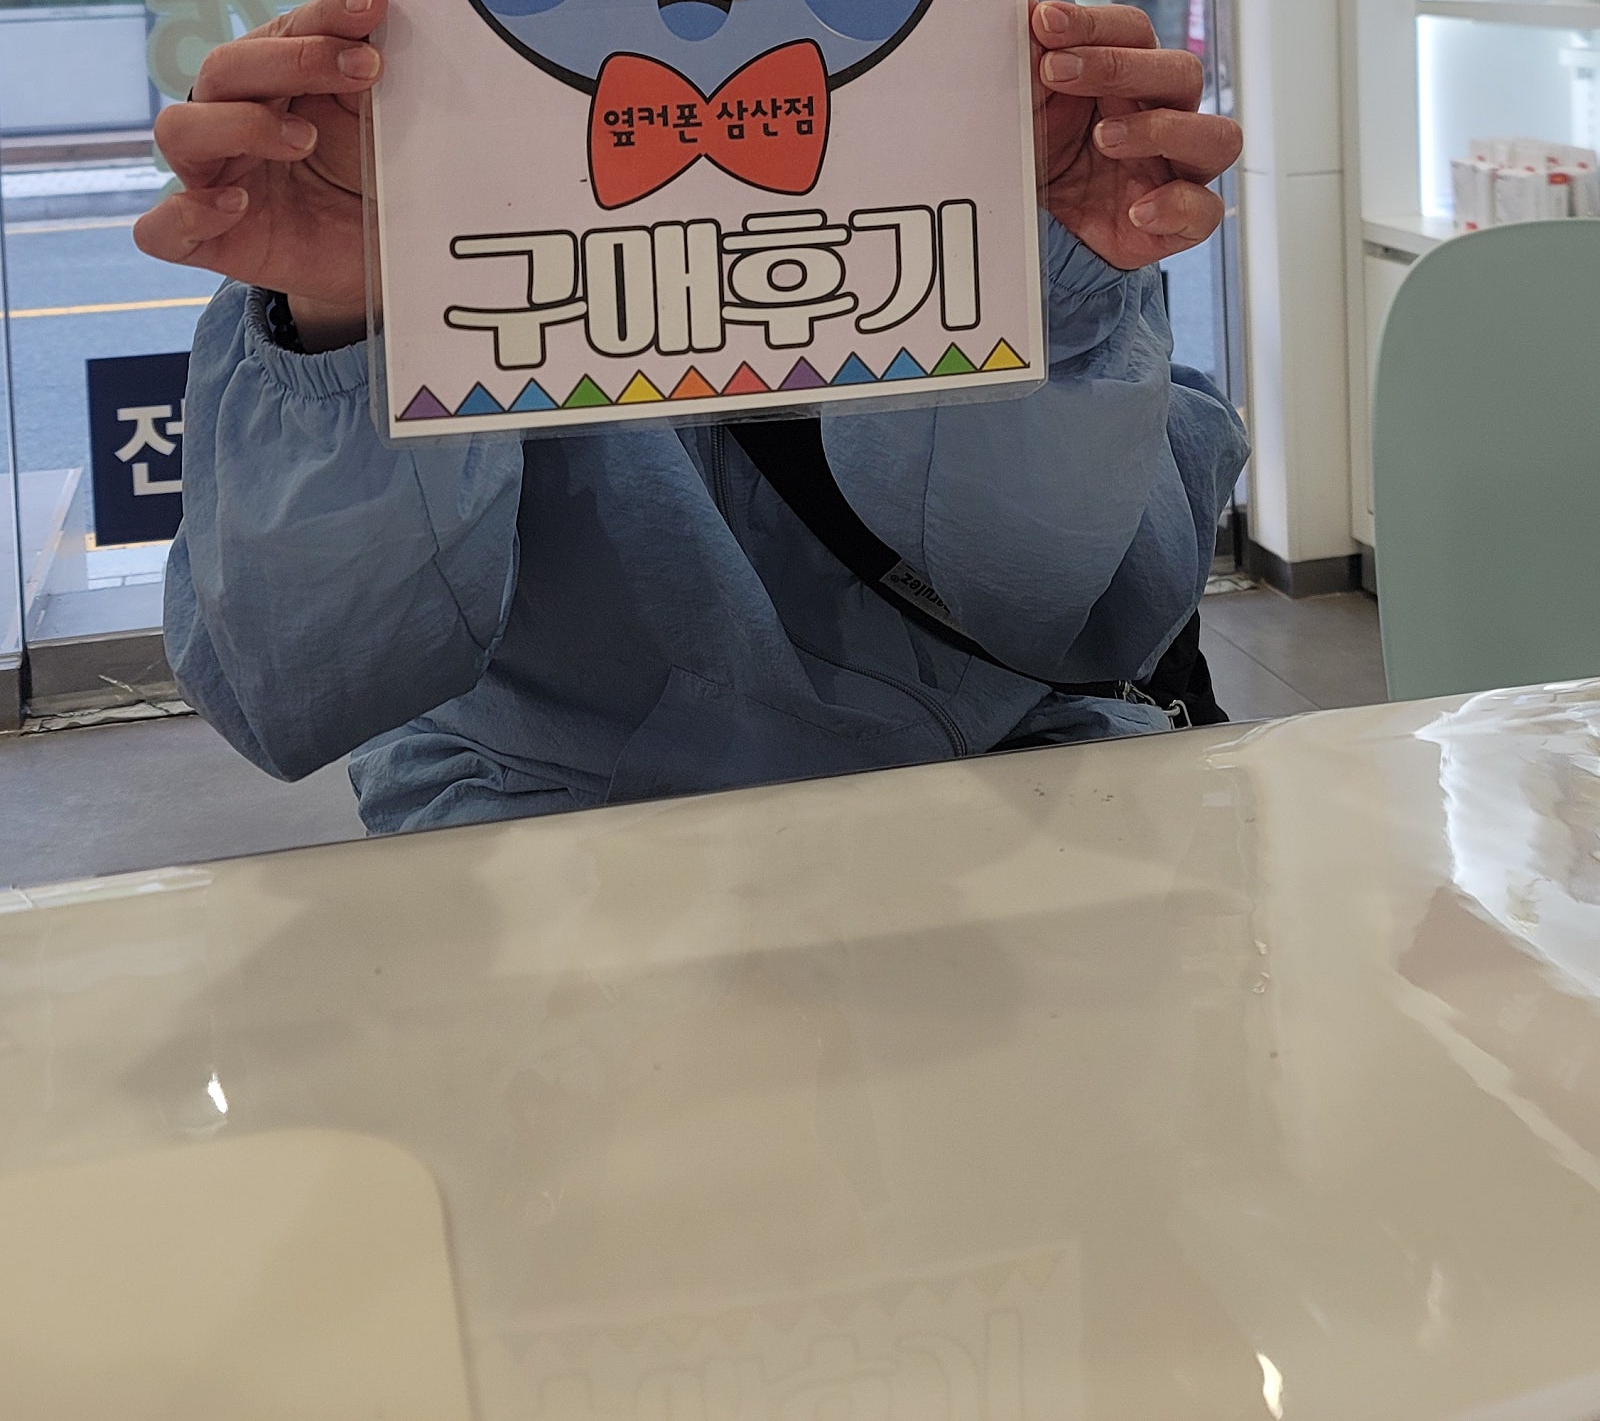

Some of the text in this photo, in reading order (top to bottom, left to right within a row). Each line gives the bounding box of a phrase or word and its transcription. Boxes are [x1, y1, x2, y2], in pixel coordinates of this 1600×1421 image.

[603, 95, 816, 147] 옆커폰 삼산점
[443, 198, 982, 369] 구매후기
